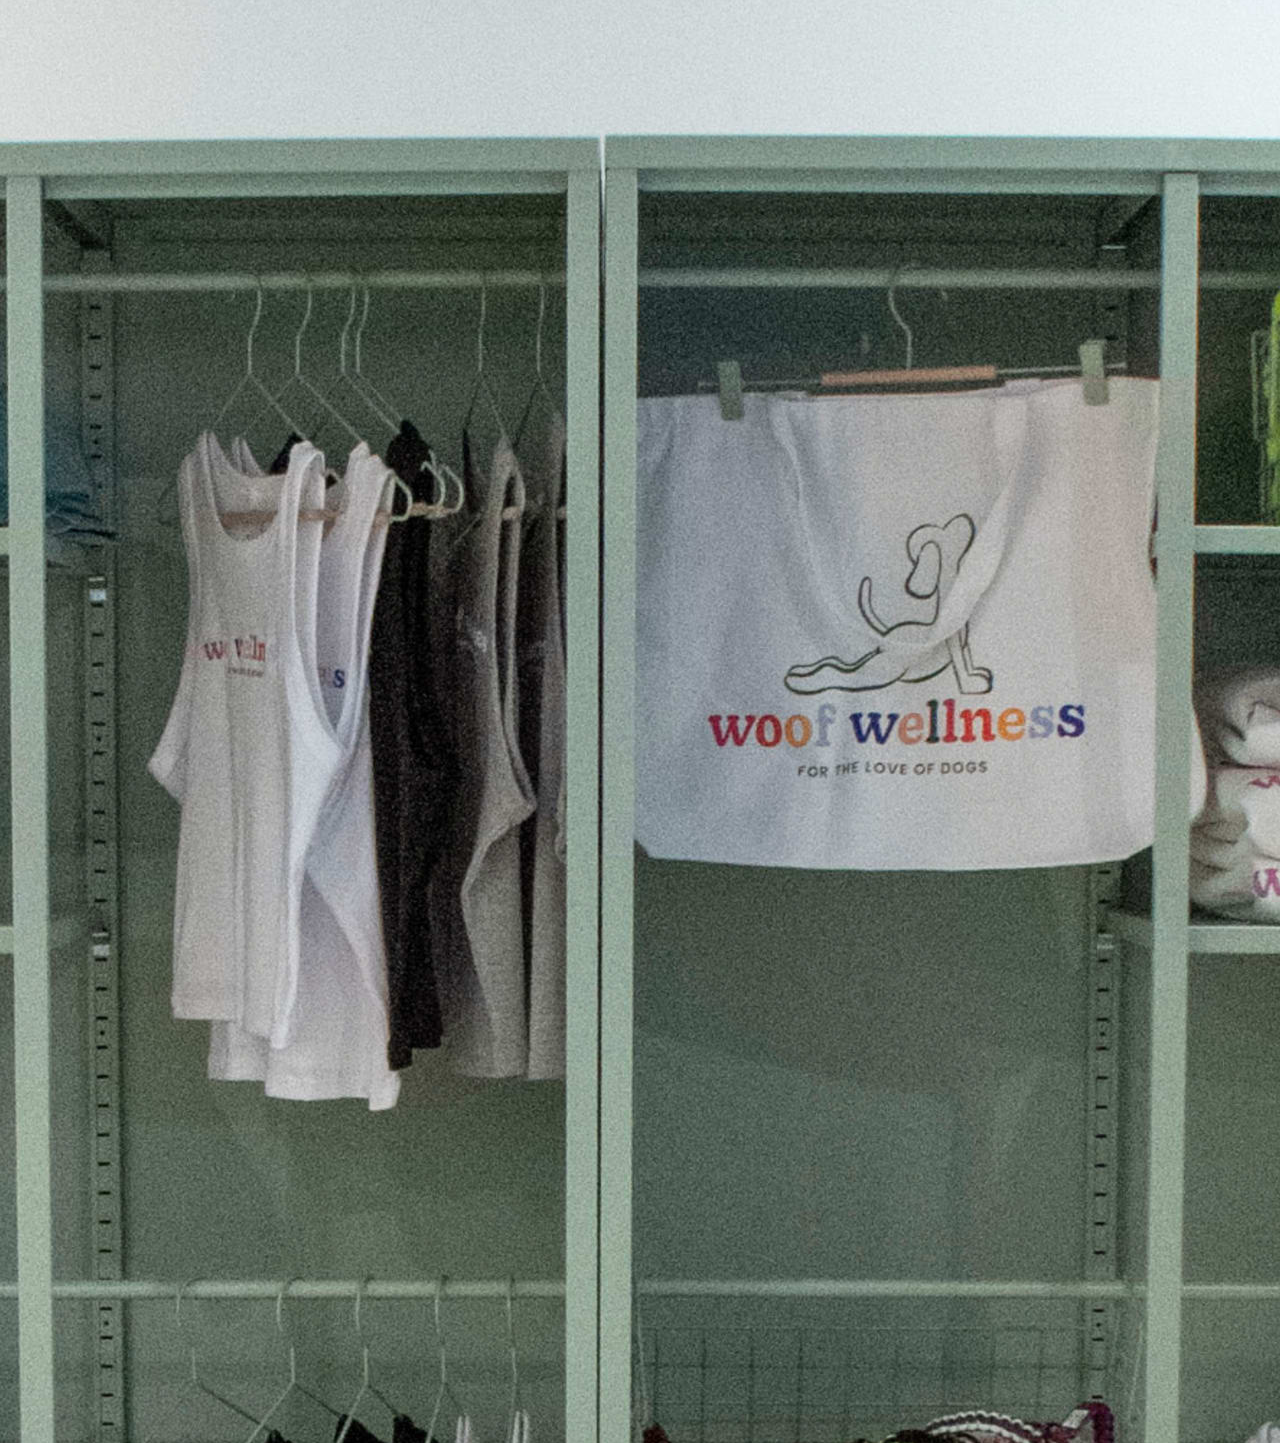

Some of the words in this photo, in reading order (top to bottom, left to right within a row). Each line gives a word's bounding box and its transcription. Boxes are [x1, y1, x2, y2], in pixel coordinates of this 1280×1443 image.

[708, 703, 837, 748] woof
[849, 698, 1086, 746] wellness
[797, 765, 828, 778] FOR
[835, 761, 859, 776] THE
[865, 761, 908, 775] LOVE
[913, 762, 935, 775] OF
[940, 761, 988, 775] DOGS
